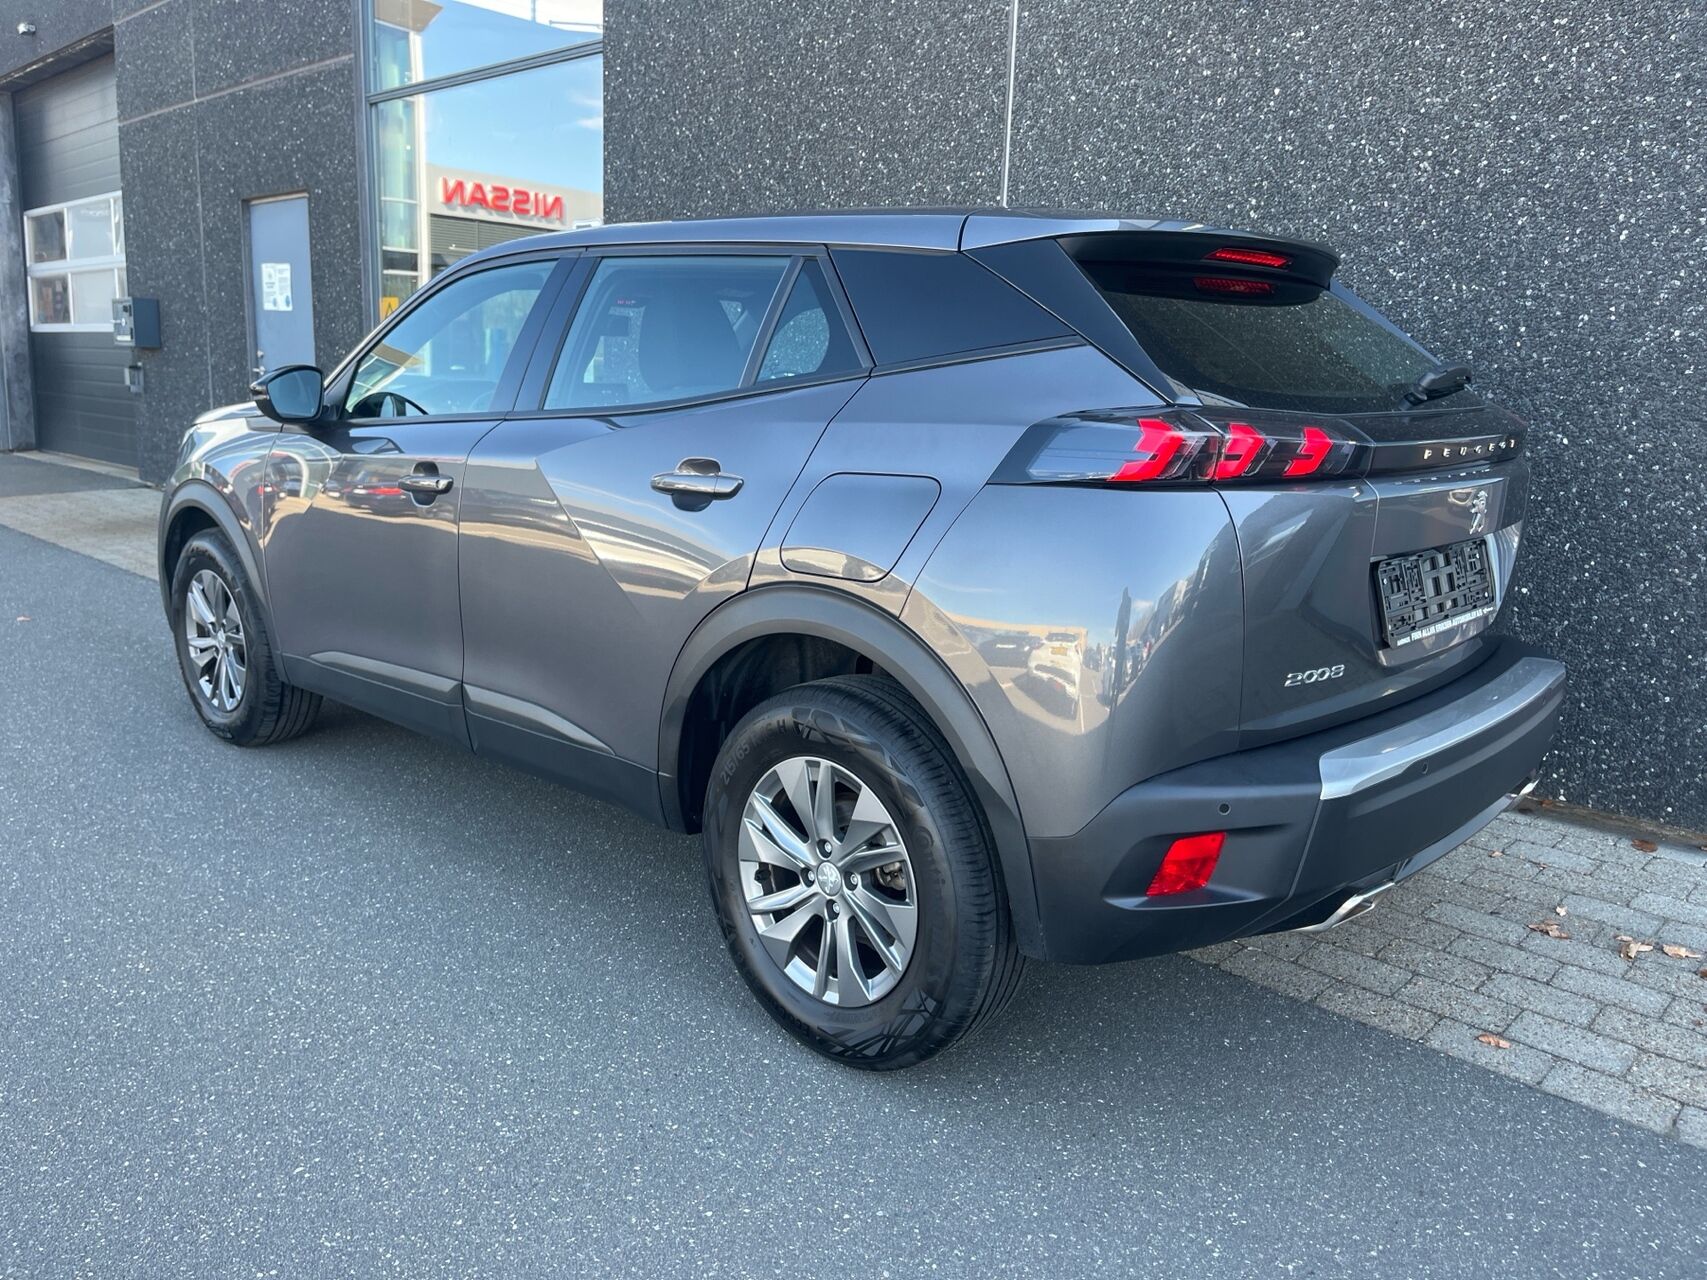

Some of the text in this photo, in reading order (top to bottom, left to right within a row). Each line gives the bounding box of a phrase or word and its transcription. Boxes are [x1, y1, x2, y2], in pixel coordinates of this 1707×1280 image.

[1423, 439, 1515, 460] PEUGEOT
[1284, 664, 1345, 687] 2008
[720, 743, 750, 785] 215/65
